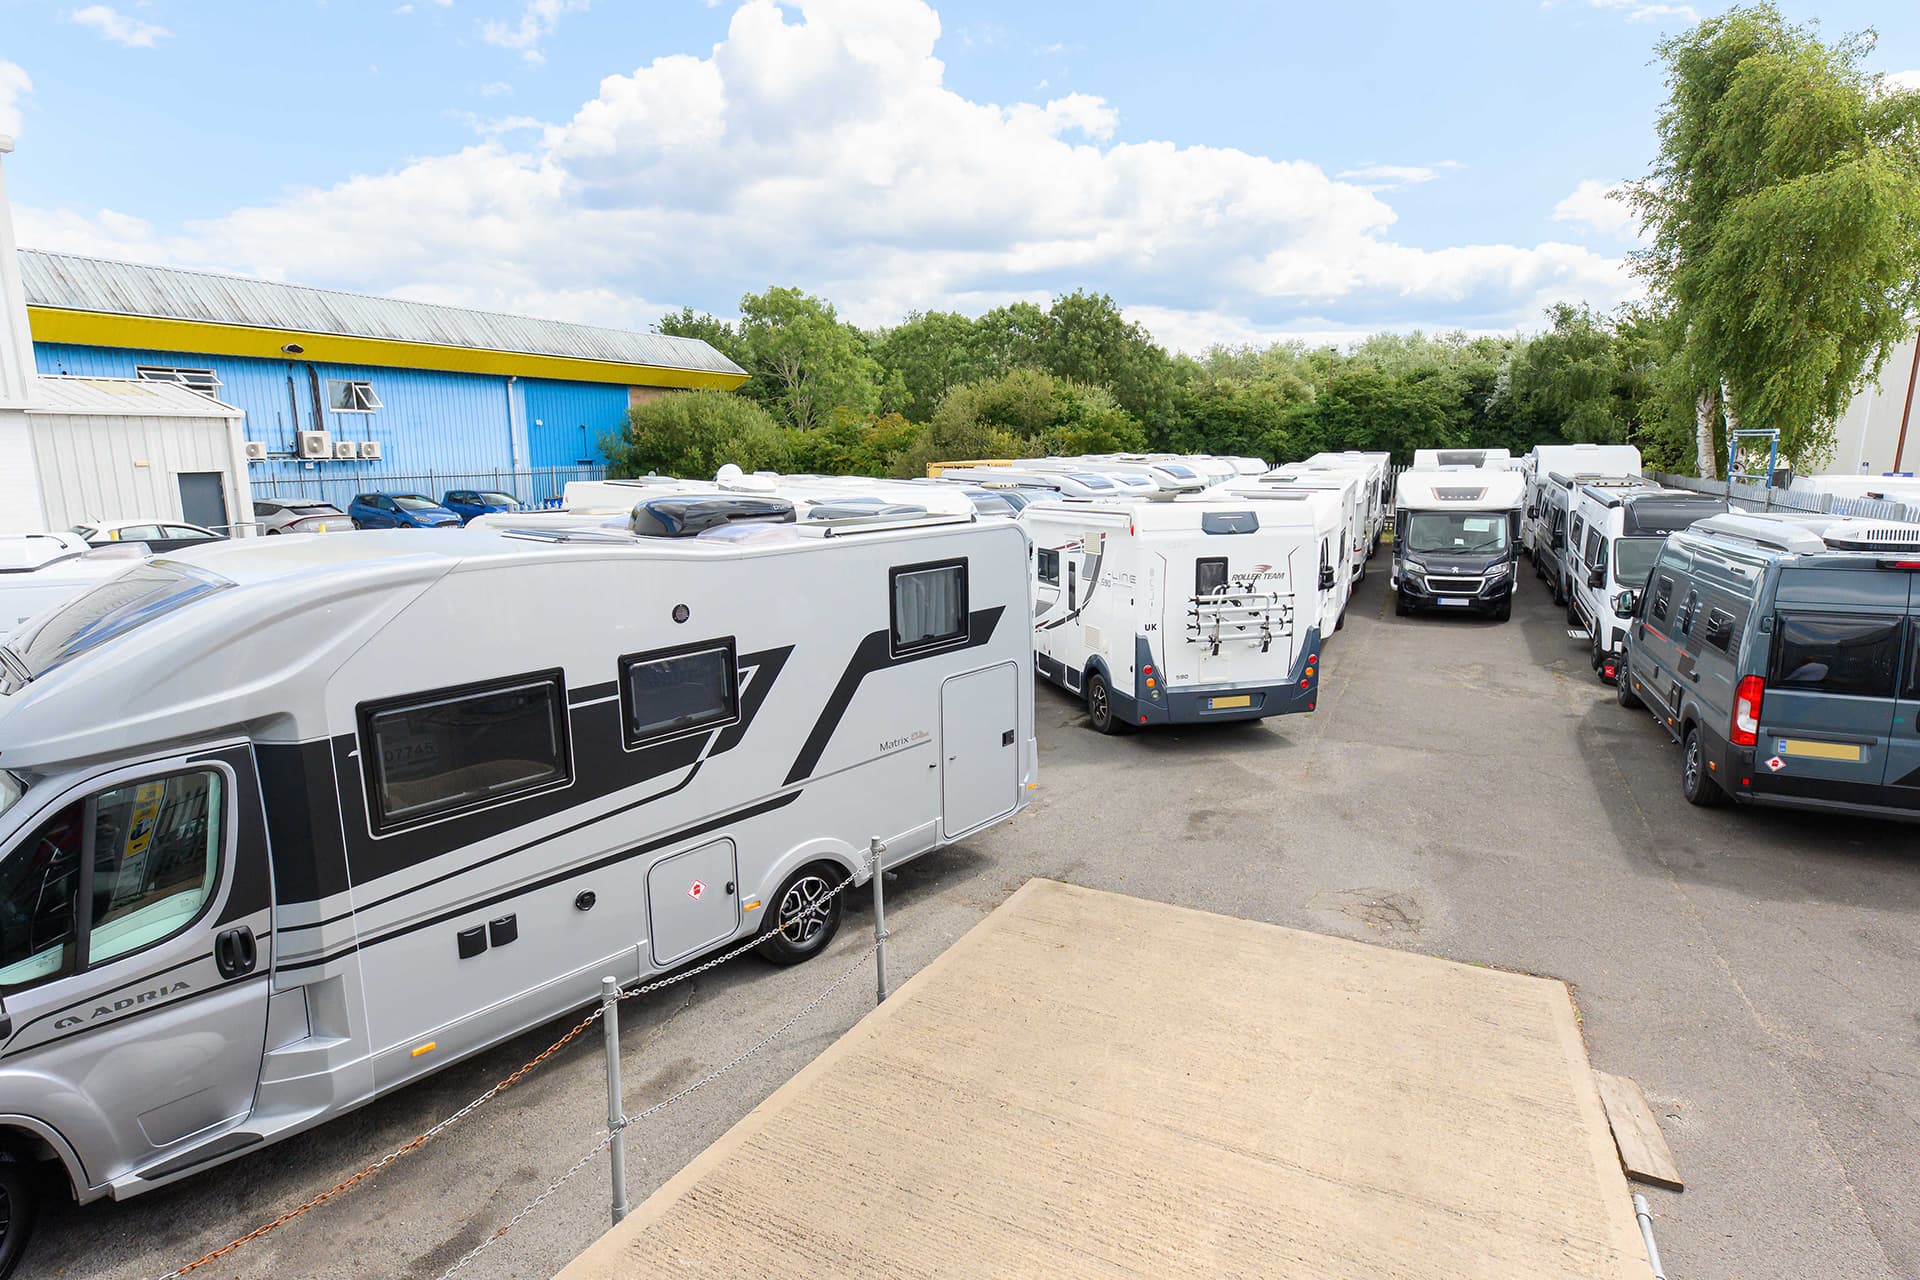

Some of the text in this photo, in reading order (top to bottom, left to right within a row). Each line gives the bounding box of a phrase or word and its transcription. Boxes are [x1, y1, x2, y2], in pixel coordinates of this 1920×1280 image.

[1231, 571, 1285, 581] ROLLER TEAM
[1144, 623, 1157, 632] UK
[879, 736, 909, 752] Matrix
[91, 981, 191, 1019] ADRIA
